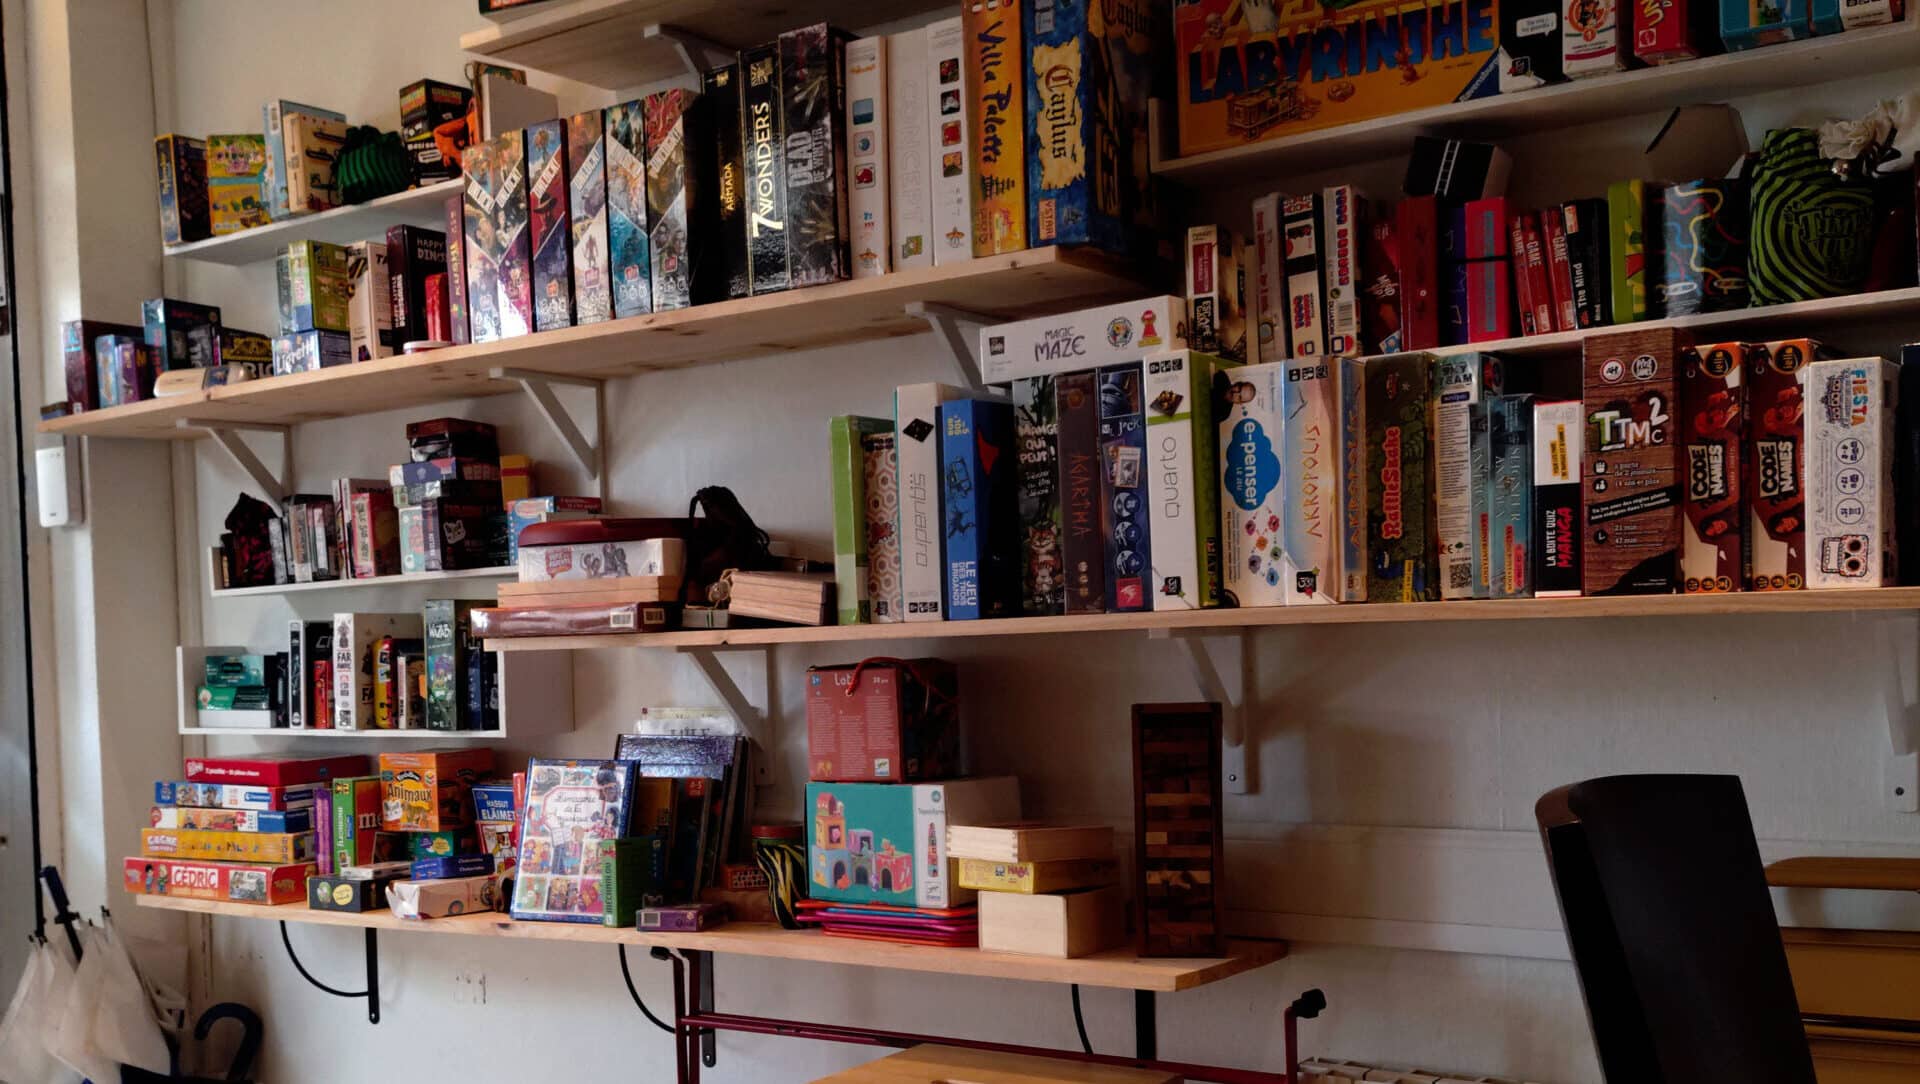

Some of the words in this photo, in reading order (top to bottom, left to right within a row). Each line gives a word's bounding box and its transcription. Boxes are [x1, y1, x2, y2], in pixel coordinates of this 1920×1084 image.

[978, 22, 1007, 82] Villa
[1189, 2, 1496, 104] LABYRINTHE
[1046, 64, 1077, 159] Caylus
[754, 101, 774, 217] WONDERS
[787, 131, 813, 187] DEAD
[901, 80, 921, 221] CONCEPT
[724, 162, 735, 210] ARMADA
[1573, 262, 1584, 289] Mind
[1577, 290, 1587, 309] The
[1034, 335, 1087, 362] MAZE
[1045, 325, 1076, 342] MAGIC
[1851, 369, 1868, 426] FIESTA
[1240, 422, 1257, 506] e-penser
[1301, 425, 1322, 539] AKROPOLIS
[1691, 448, 1707, 497] CODE
[1709, 444, 1725, 496] NAMES
[1761, 445, 1777, 494] CODE
[1778, 441, 1794, 493] NAMES
[1545, 509, 1556, 528] QUIZ
[1556, 507, 1574, 567] MANGA
[952, 562, 960, 607] BRIGANDS
[959, 580, 967, 606] TROIS
[966, 560, 977, 577] LE
[966, 580, 977, 606] JEU
[387, 783, 432, 802] Animaux
